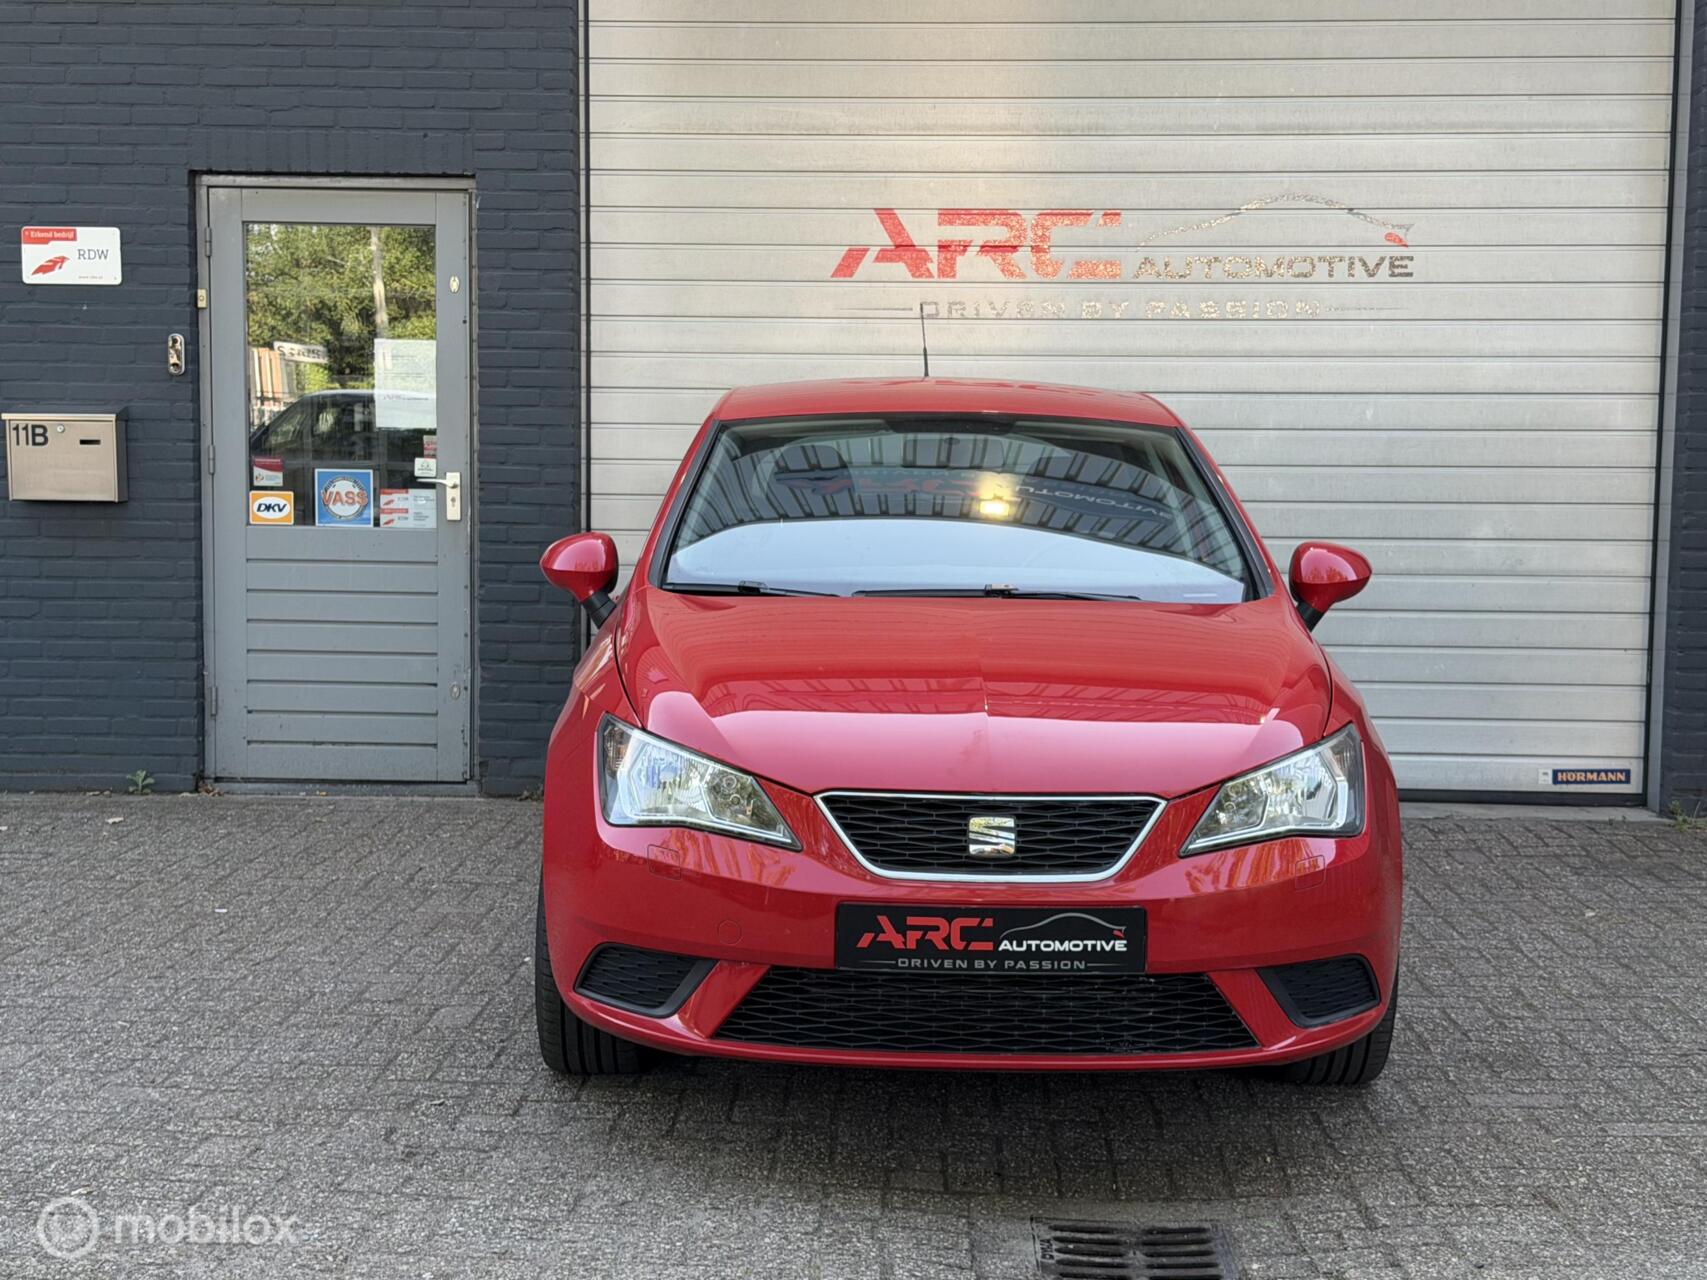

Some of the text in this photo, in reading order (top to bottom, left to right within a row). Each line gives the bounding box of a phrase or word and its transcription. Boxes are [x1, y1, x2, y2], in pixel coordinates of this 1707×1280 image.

[830, 208, 1121, 279] ARC
[77, 248, 109, 260] RDW
[1132, 255, 1414, 279] AUTOMOTIVE
[919, 300, 1321, 319] DRIVEN BY PASSION
[12, 424, 49, 446] 11B
[320, 490, 368, 506] VASS
[256, 503, 287, 512] DKV
[856, 915, 994, 950] ARC
[998, 940, 1128, 952] AUTOMOTIVE
[898, 957, 1086, 970] DRIVEN BY PASSION
